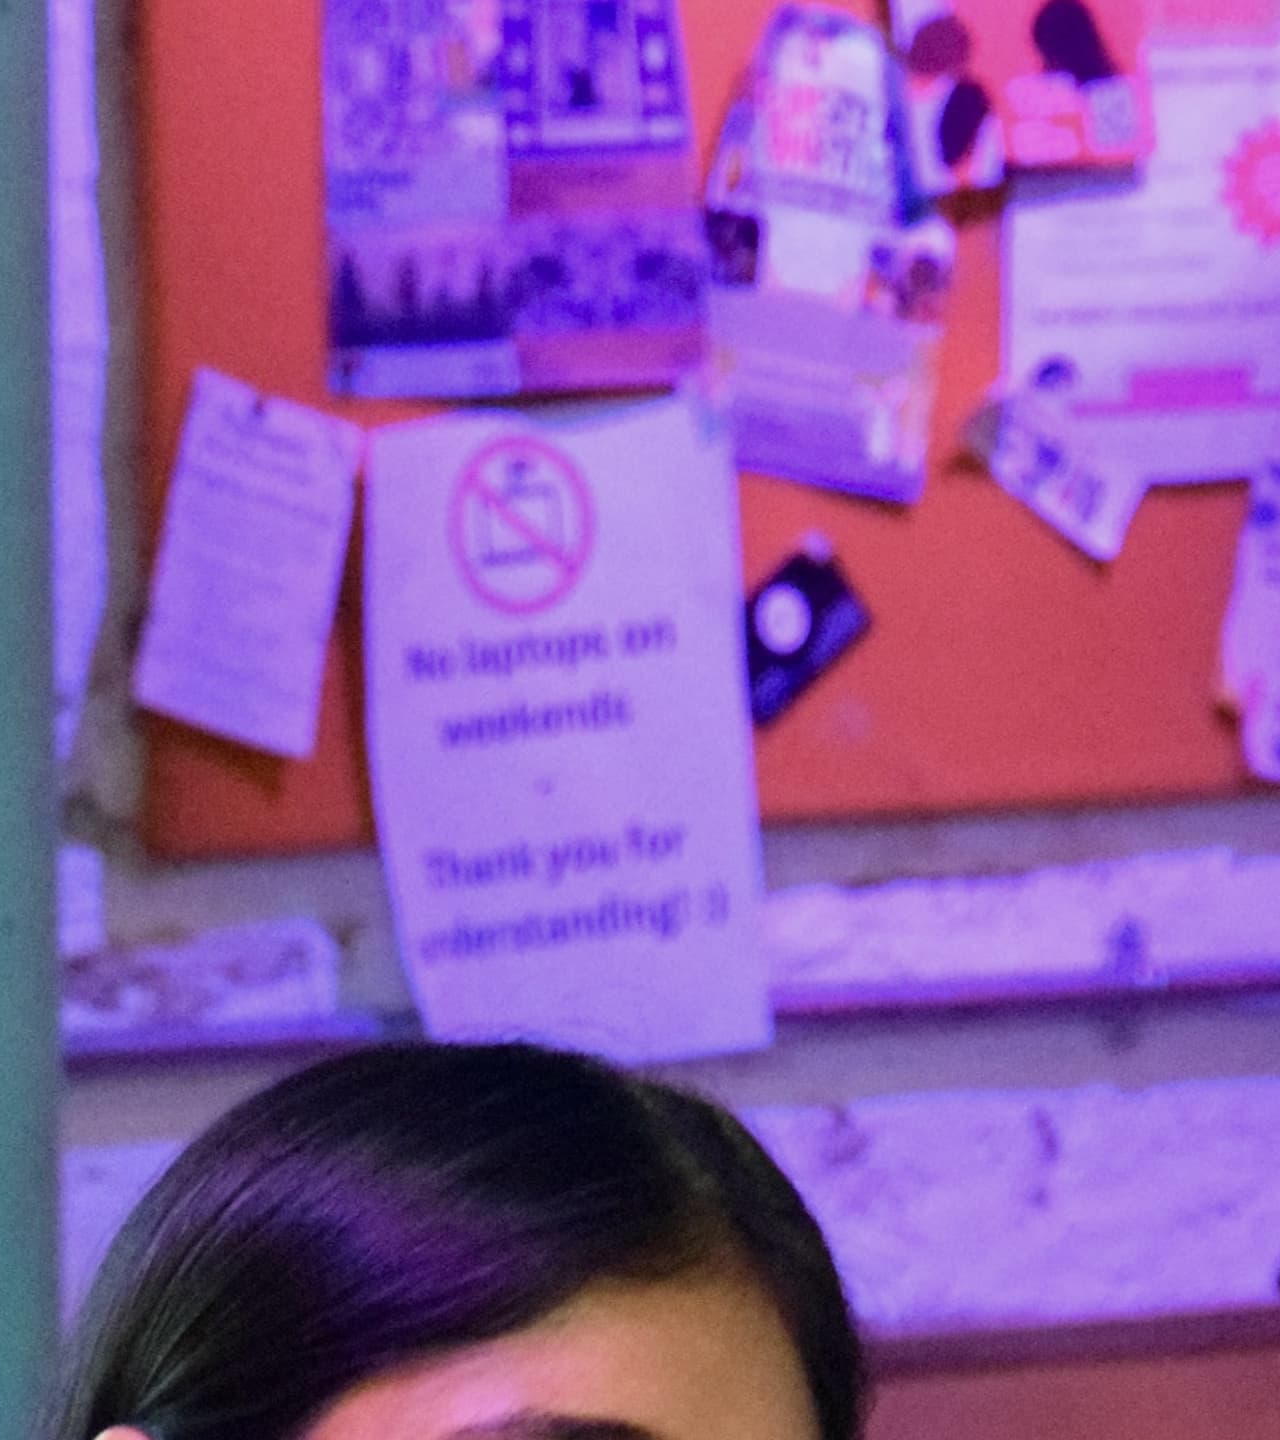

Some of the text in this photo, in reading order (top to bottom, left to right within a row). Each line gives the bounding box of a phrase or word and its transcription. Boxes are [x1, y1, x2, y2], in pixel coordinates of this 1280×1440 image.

[405, 621, 674, 679] No laptops on
[442, 692, 628, 746] weekends
[424, 824, 684, 888] Thank you for
